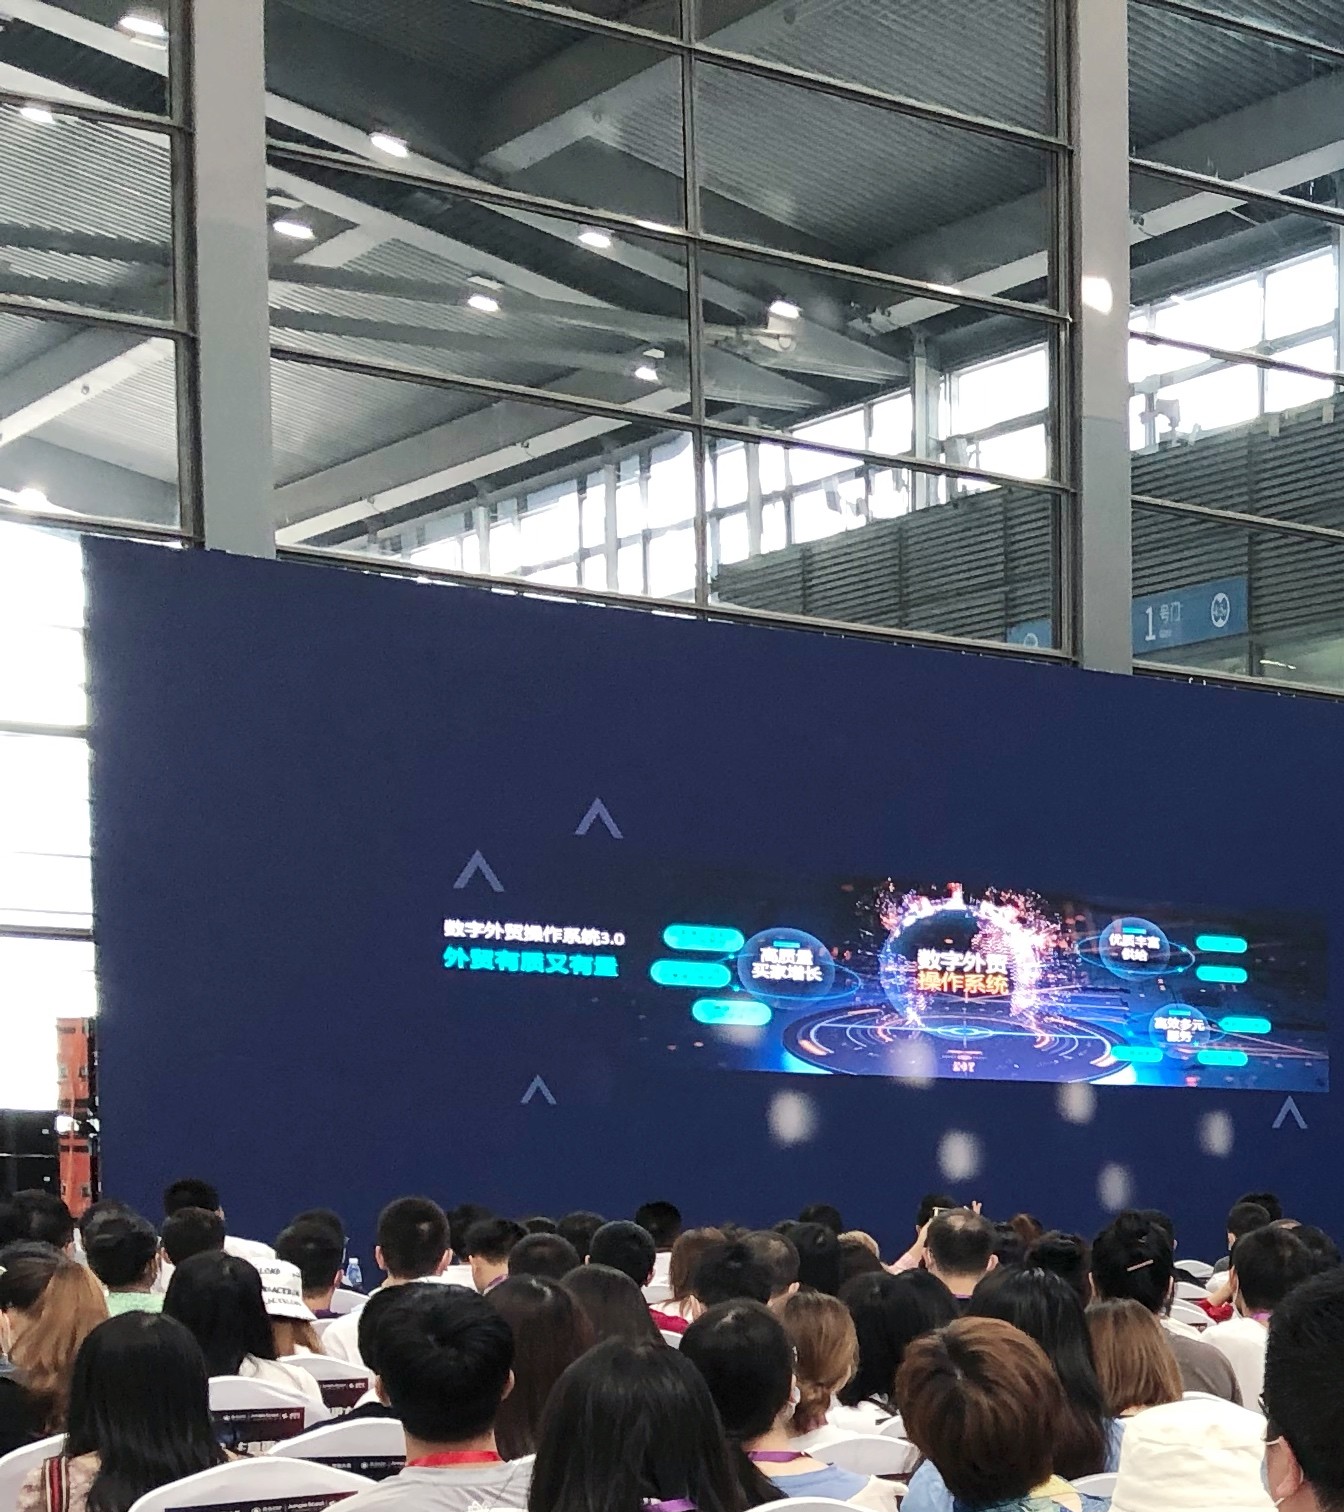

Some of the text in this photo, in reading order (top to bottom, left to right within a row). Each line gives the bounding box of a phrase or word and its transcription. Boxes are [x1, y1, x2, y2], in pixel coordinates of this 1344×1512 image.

[1145, 606, 1156, 641] 1
[918, 971, 1009, 994] 操作系统
